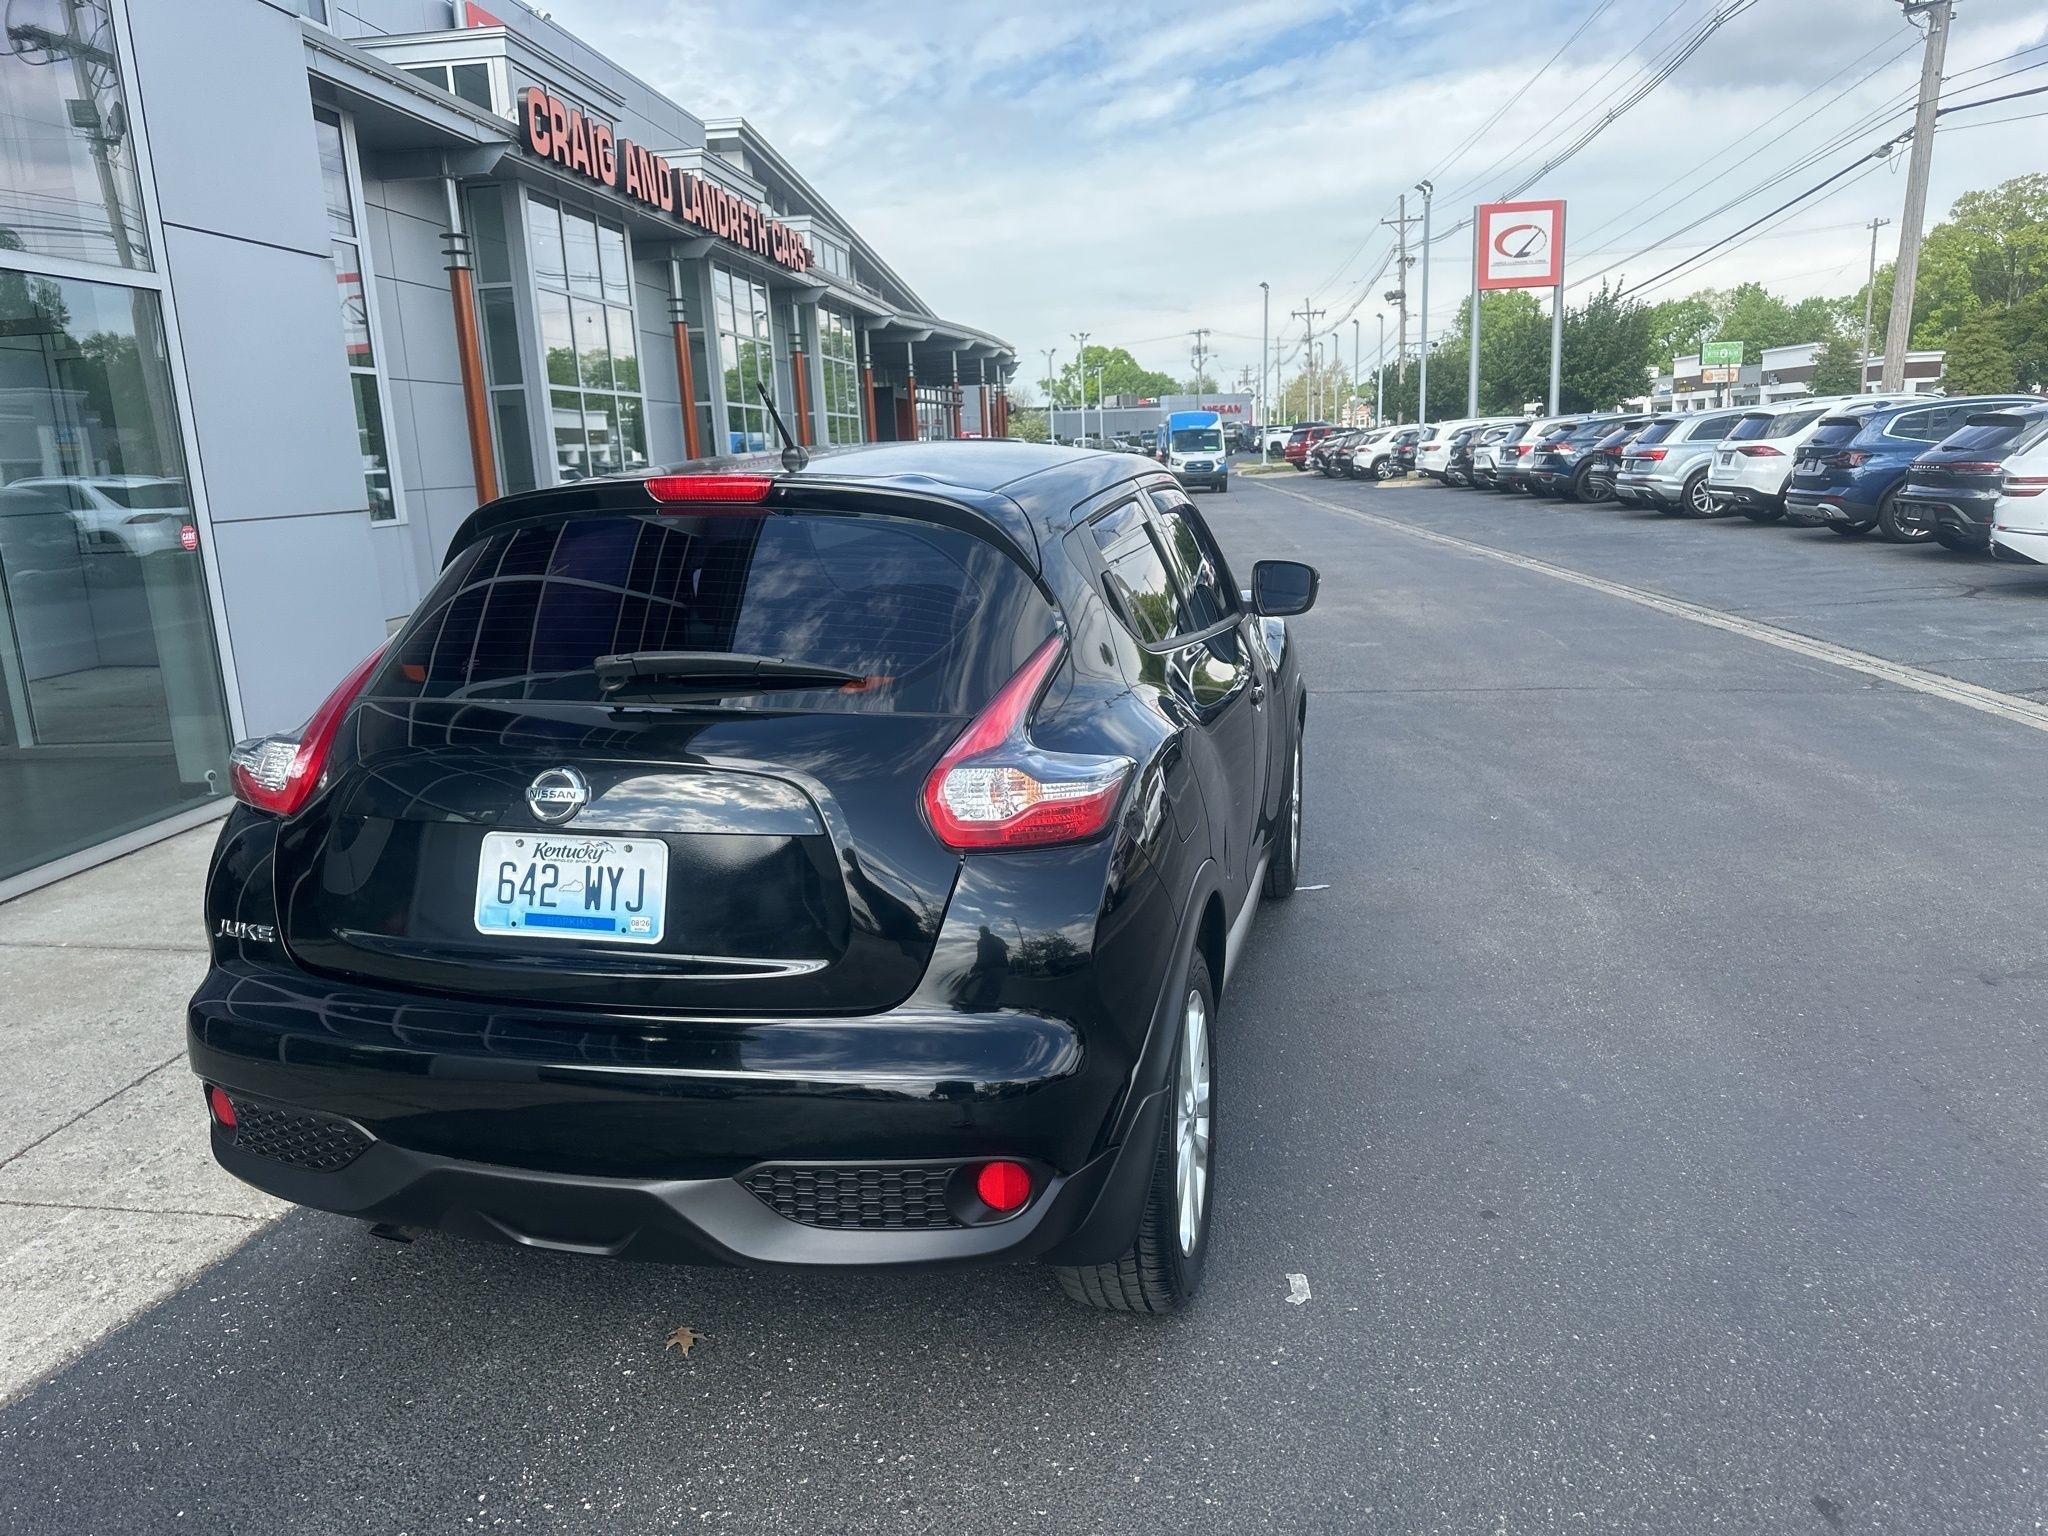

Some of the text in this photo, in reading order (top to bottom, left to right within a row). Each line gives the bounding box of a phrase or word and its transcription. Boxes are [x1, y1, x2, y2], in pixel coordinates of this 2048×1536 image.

[526, 86, 806, 272] CRAIG AND LANDRETH CARS
[1202, 405, 1241, 414] NISSAN
[530, 790, 576, 799] NISSAN
[532, 842, 604, 863] Kentucky
[498, 861, 645, 913] 642 WYJ
[215, 919, 275, 942] JUKE
